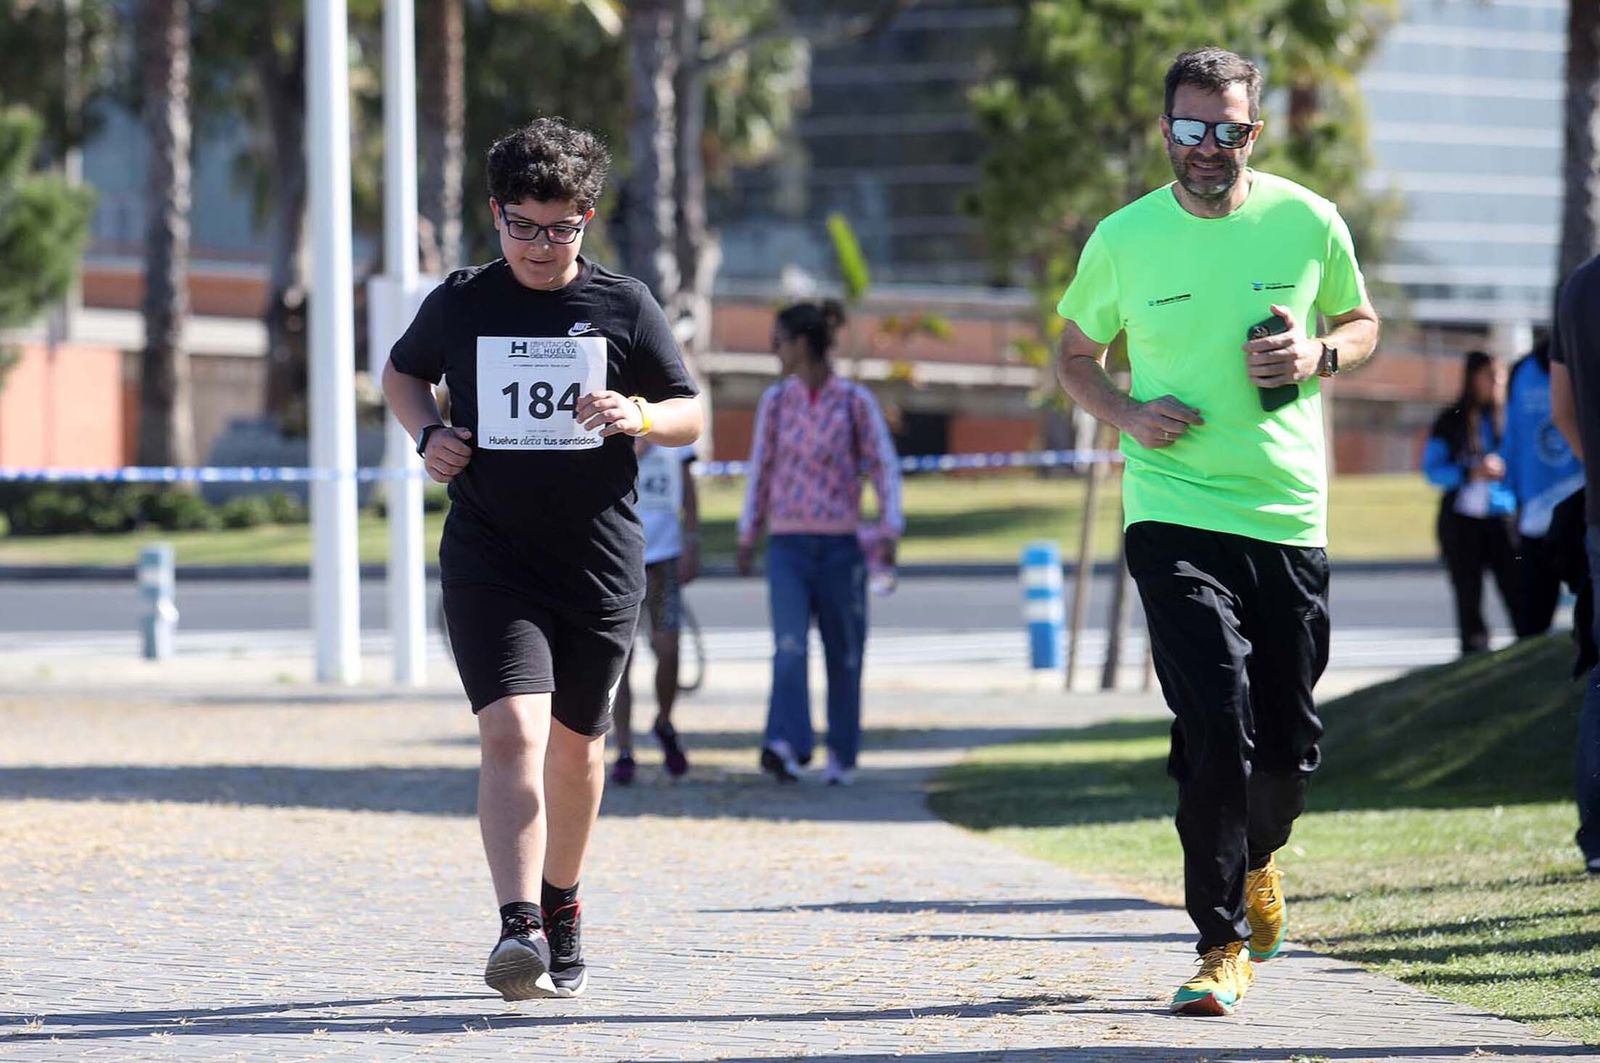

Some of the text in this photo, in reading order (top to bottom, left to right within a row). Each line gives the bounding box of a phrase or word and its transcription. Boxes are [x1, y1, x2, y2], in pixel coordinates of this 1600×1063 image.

[572, 322, 592, 332] NIKE
[502, 381, 581, 420] 184
[489, 435, 518, 445] Huelva
[544, 436, 558, 446] tus
